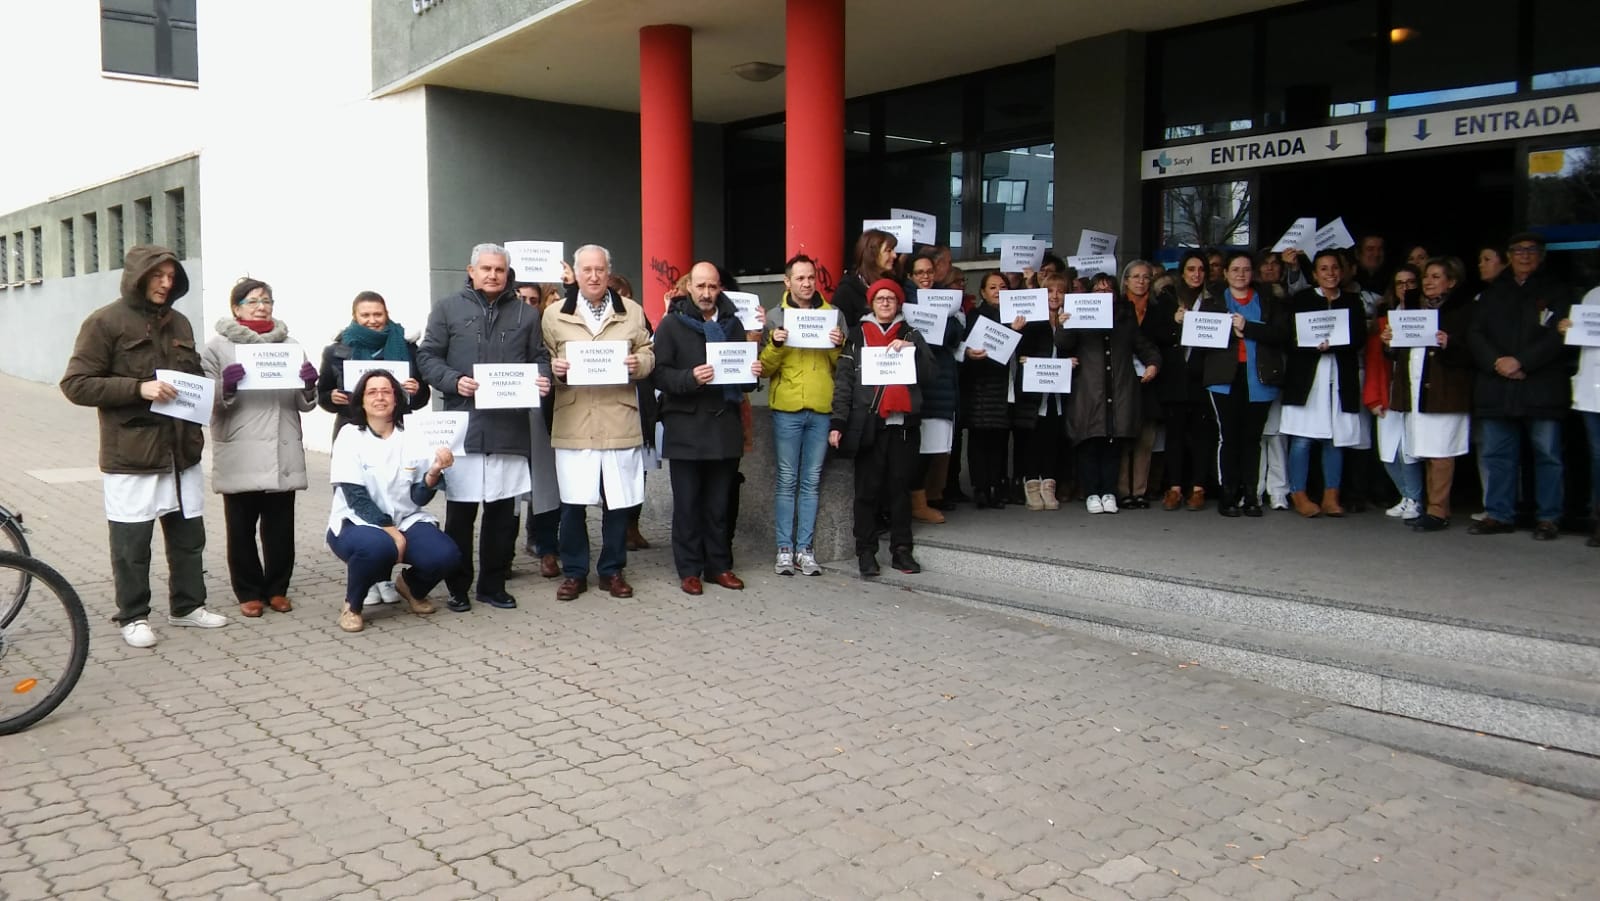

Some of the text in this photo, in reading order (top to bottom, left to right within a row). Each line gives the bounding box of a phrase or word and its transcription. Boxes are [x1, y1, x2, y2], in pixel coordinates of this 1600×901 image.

[1455, 103, 1579, 137] ENTRADA
[1174, 157, 1193, 169] Sacyl
[1211, 136, 1307, 165] ENTRADA
